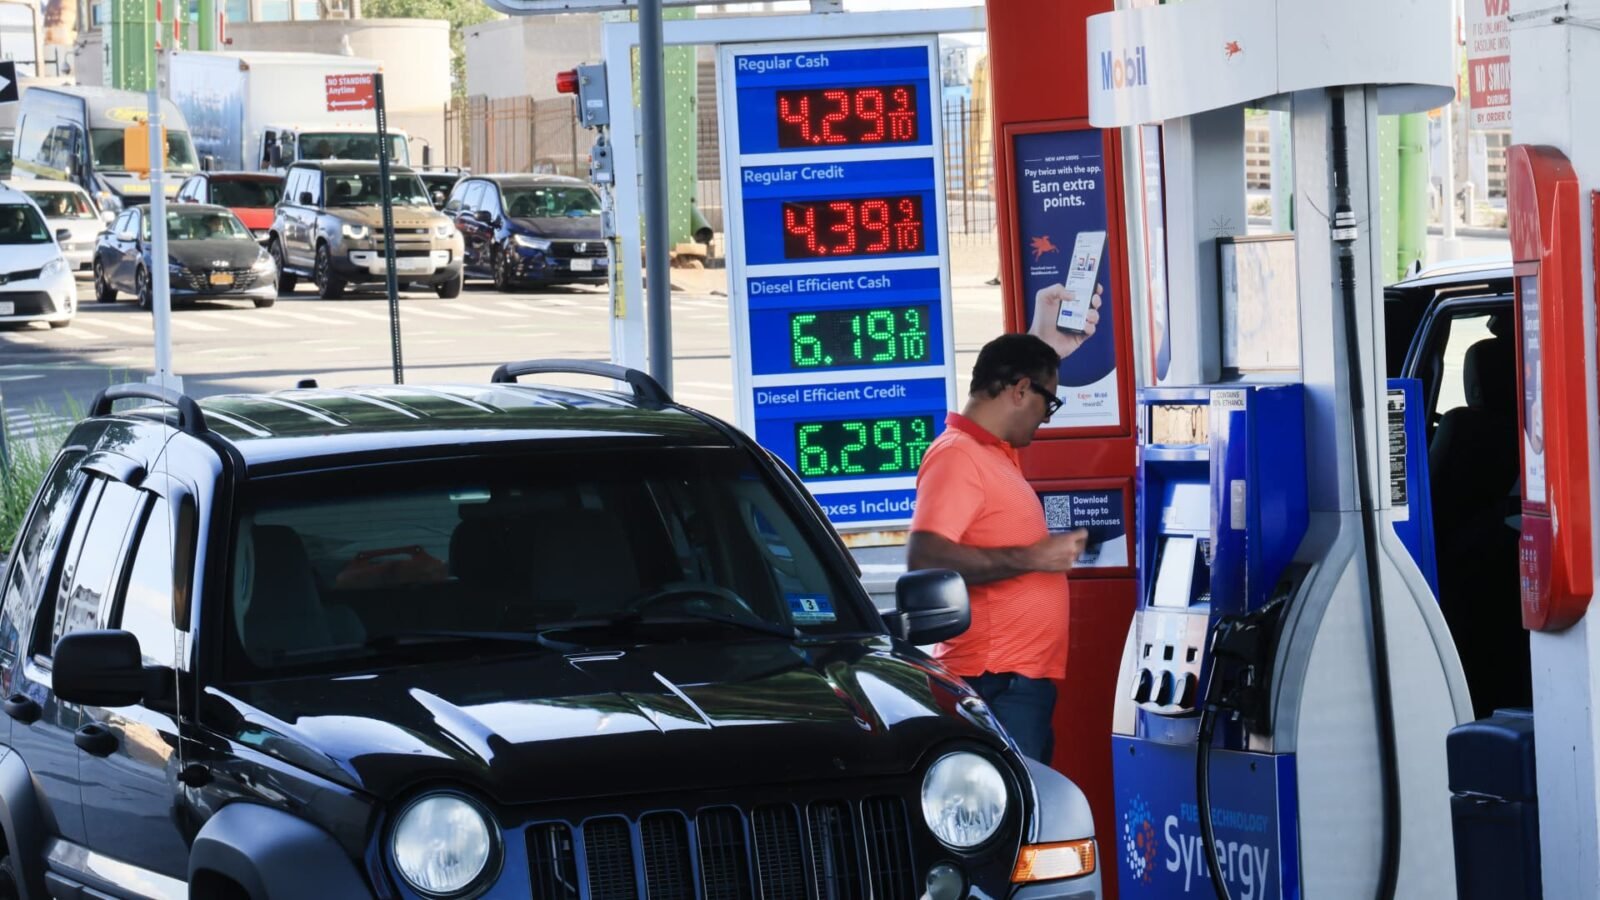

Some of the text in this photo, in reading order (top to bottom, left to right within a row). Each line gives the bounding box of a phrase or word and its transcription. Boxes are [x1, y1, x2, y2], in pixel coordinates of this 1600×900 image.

[738, 54, 829, 73] Regular Cash
[1101, 46, 1148, 90] Mobil
[327, 76, 371, 86] NO STANDING
[1474, 64, 1486, 93] NO
[329, 87, 356, 96] Anytime
[780, 89, 884, 143] 4.29
[1477, 113, 1485, 123] BY
[1487, 111, 1505, 122] ORDER
[744, 165, 844, 185] Regular Credit
[1024, 165, 1101, 178] Pay twice with the app.
[1032, 178, 1095, 193] Earn extra
[1043, 193, 1085, 212] points.
[786, 200, 890, 254] 4.39
[751, 275, 891, 295] Diesel Efficient Cash
[792, 310, 896, 366] 6.19
[757, 385, 907, 405] Diesel Efficient Credit
[799, 420, 902, 476] 6.29
[821, 503, 857, 515] axes
[1073, 495, 1108, 504] Download
[1091, 517, 1120, 526] bonuses
[806, 600, 814, 610] 3
[1180, 803, 1269, 833] FUE ECHNOLOGY
[1164, 815, 1270, 900] Synergy
